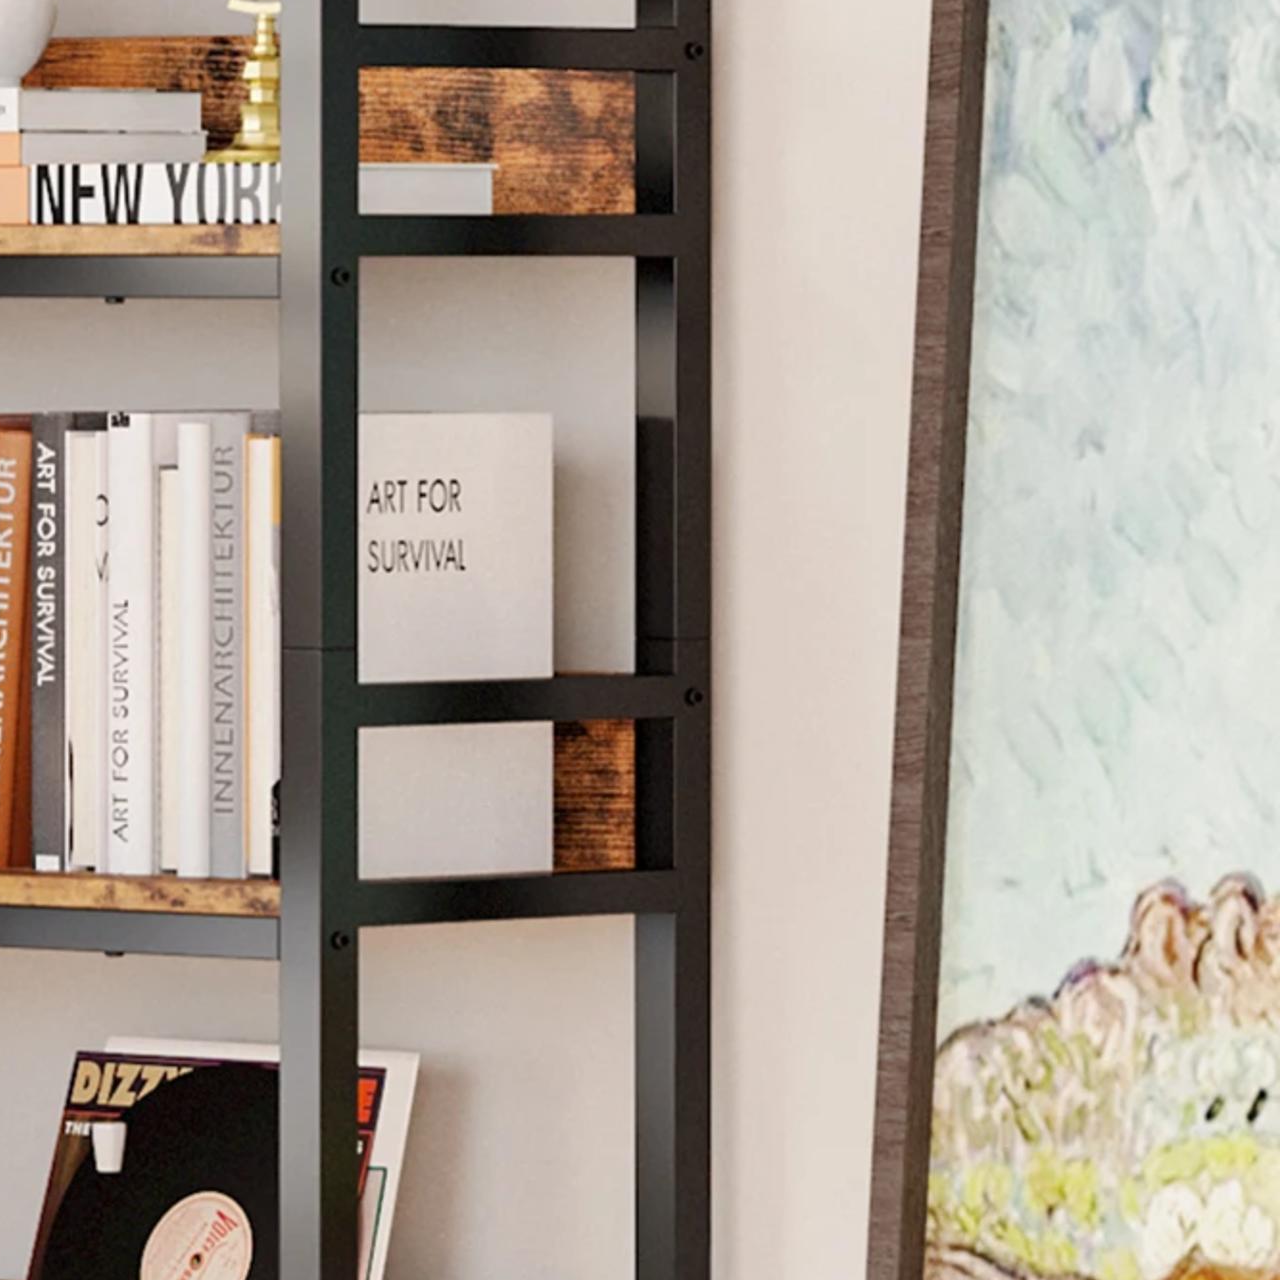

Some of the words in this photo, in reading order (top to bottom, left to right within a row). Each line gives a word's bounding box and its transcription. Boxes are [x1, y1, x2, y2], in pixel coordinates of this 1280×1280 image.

[37, 443, 56, 494] ART
[366, 481, 407, 514] ART
[417, 478, 462, 513] FOR
[37, 502, 56, 557] FOR
[367, 539, 466, 573] SURVIVAL
[37, 566, 56, 687] SURVIVAL
[214, 445, 234, 814] INNENARCHITEKTUR
[112, 600, 128, 719] SURVIVAL
[112, 729, 128, 782] FOR
[112, 794, 128, 843] ART
